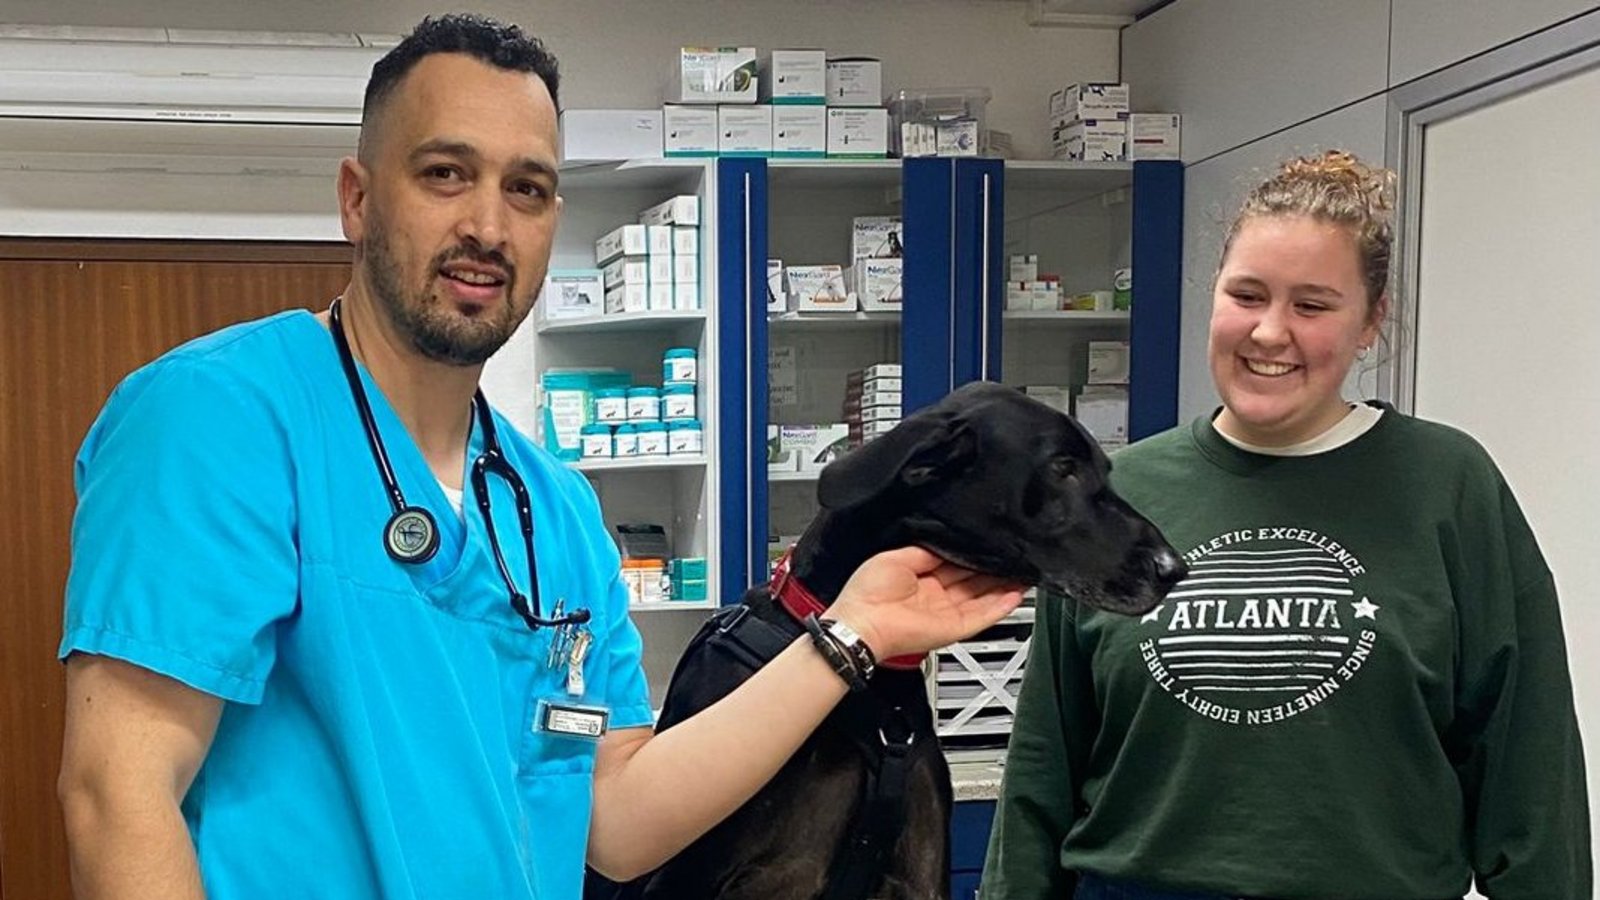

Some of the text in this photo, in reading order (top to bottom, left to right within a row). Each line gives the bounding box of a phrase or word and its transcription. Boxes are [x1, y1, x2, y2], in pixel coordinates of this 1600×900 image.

[855, 222, 896, 232] NexGard
[789, 271, 831, 279] NexGard
[867, 265, 901, 275] NexGa
[1182, 527, 1366, 577] HLETIC EXCELLENCE
[1168, 598, 1342, 630] ATLANTA
[1139, 629, 1376, 725] SINCE NINETEEN EIGHTY THREE
